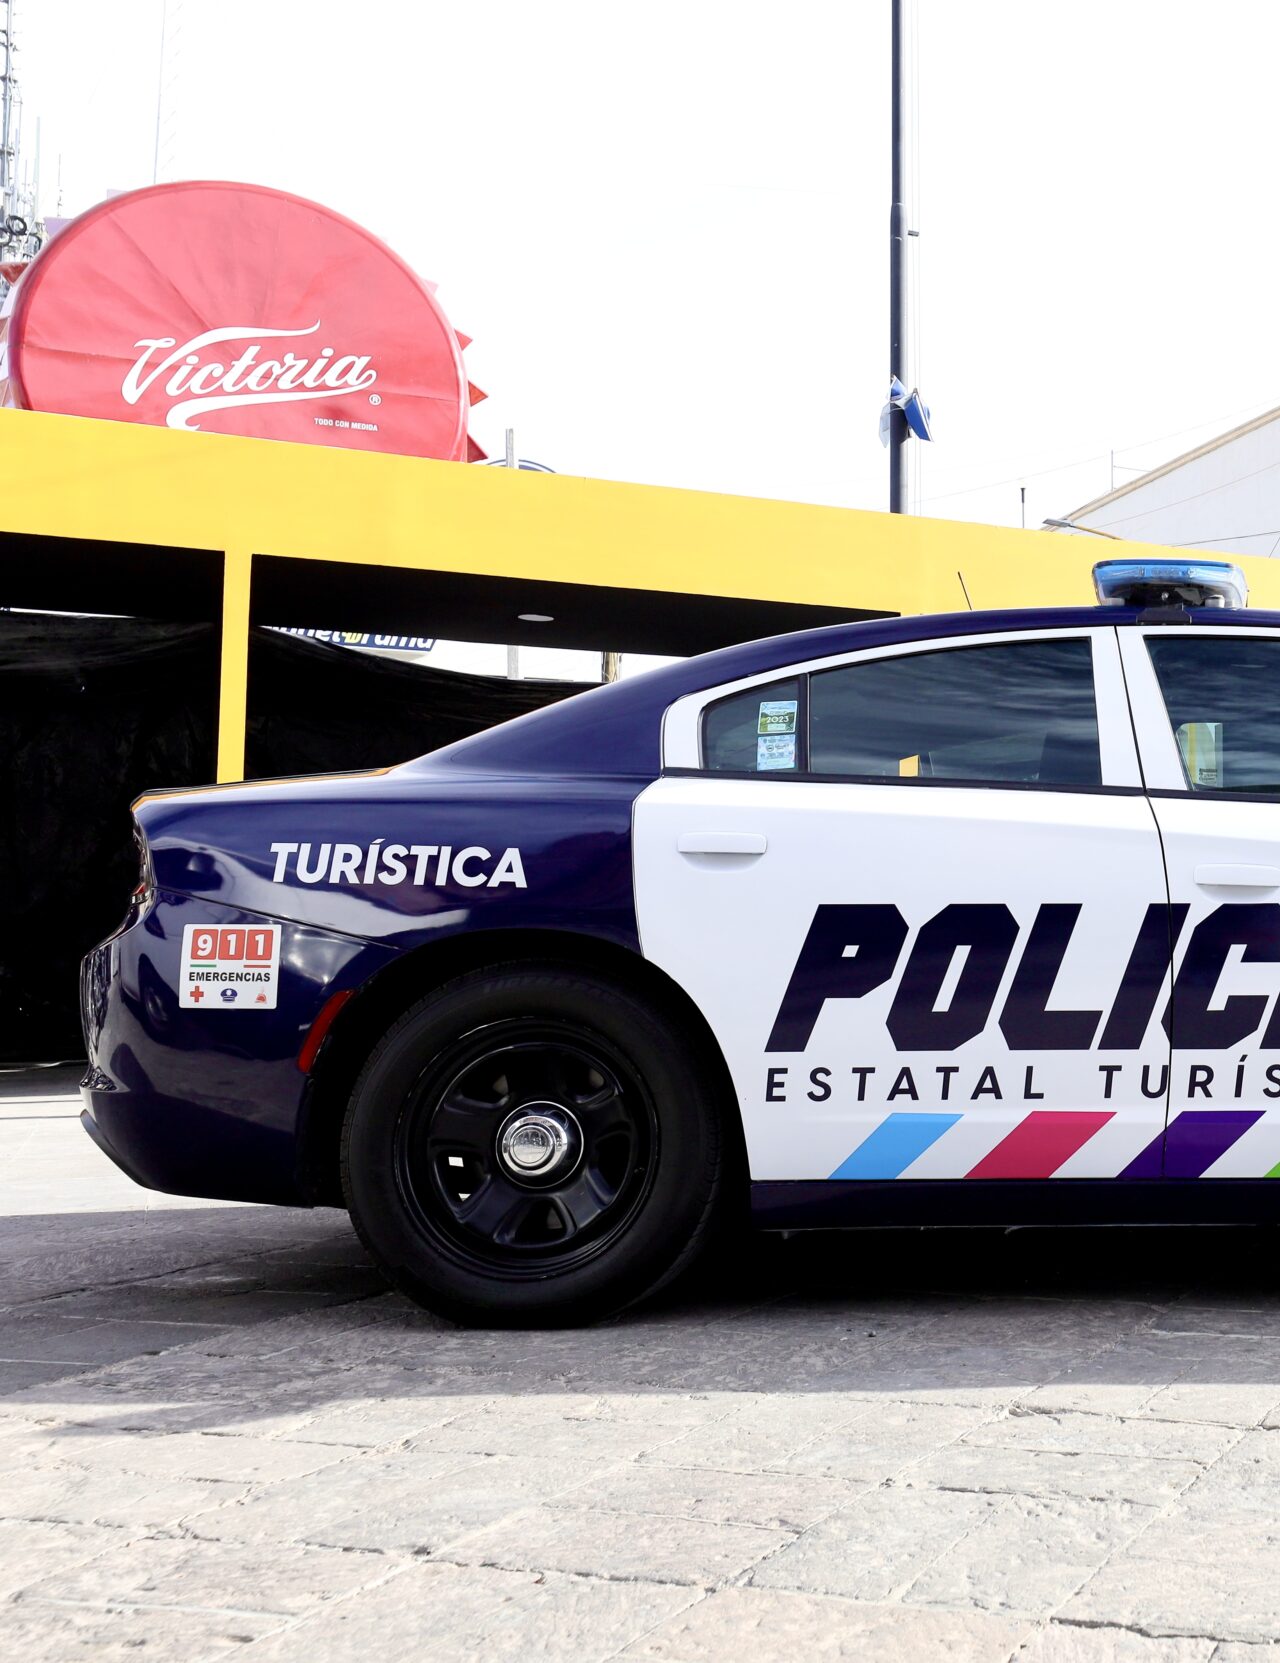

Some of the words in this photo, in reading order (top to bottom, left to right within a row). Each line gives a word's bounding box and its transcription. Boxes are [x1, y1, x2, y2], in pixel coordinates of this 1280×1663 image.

[121, 318, 377, 431] Victoria
[314, 417, 333, 426] TODO
[335, 420, 350, 428] CON
[351, 422, 378, 431] MEDIDA
[766, 715, 789, 724] 2023
[269, 839, 528, 889] TURÍSTICA
[196, 933, 265, 957] 911
[188, 971, 271, 982] EMERGENCIAS
[765, 1066, 1045, 1102] ESTATAL
